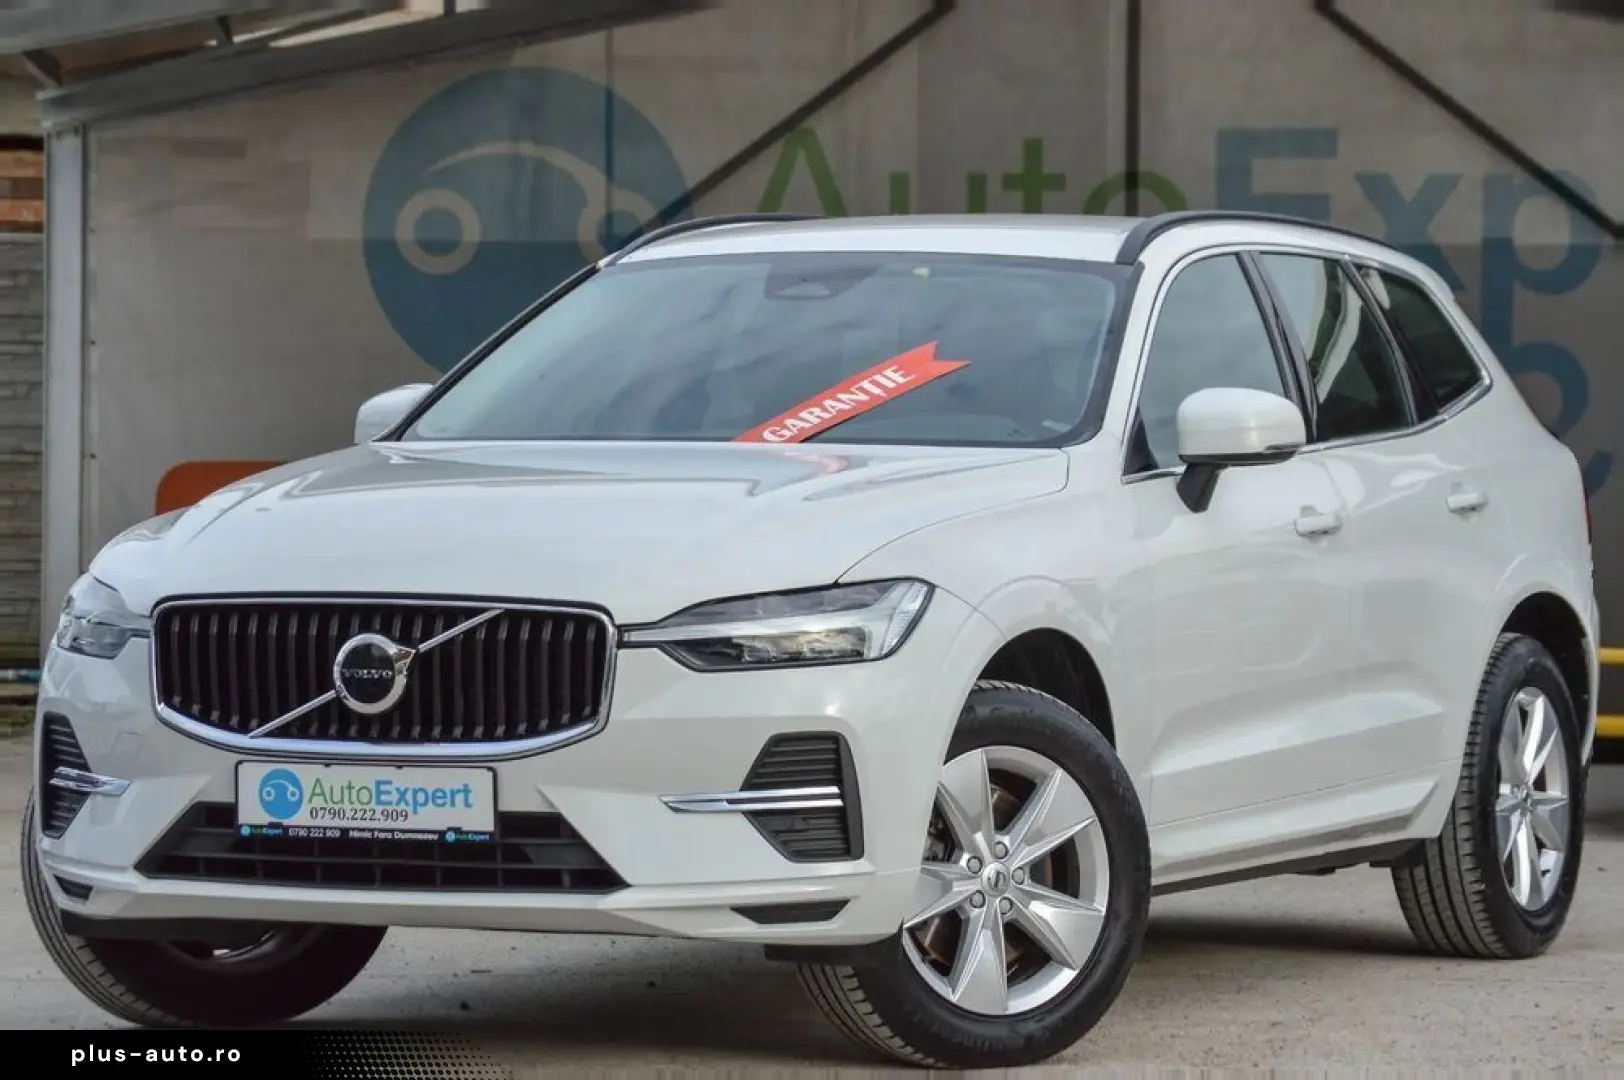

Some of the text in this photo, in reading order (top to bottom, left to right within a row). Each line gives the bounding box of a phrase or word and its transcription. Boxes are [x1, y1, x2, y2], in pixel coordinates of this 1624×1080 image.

[308, 777, 473, 815] AutoExpert
[309, 806, 409, 823] 0790.222.909
[309, 827, 324, 838] 222
